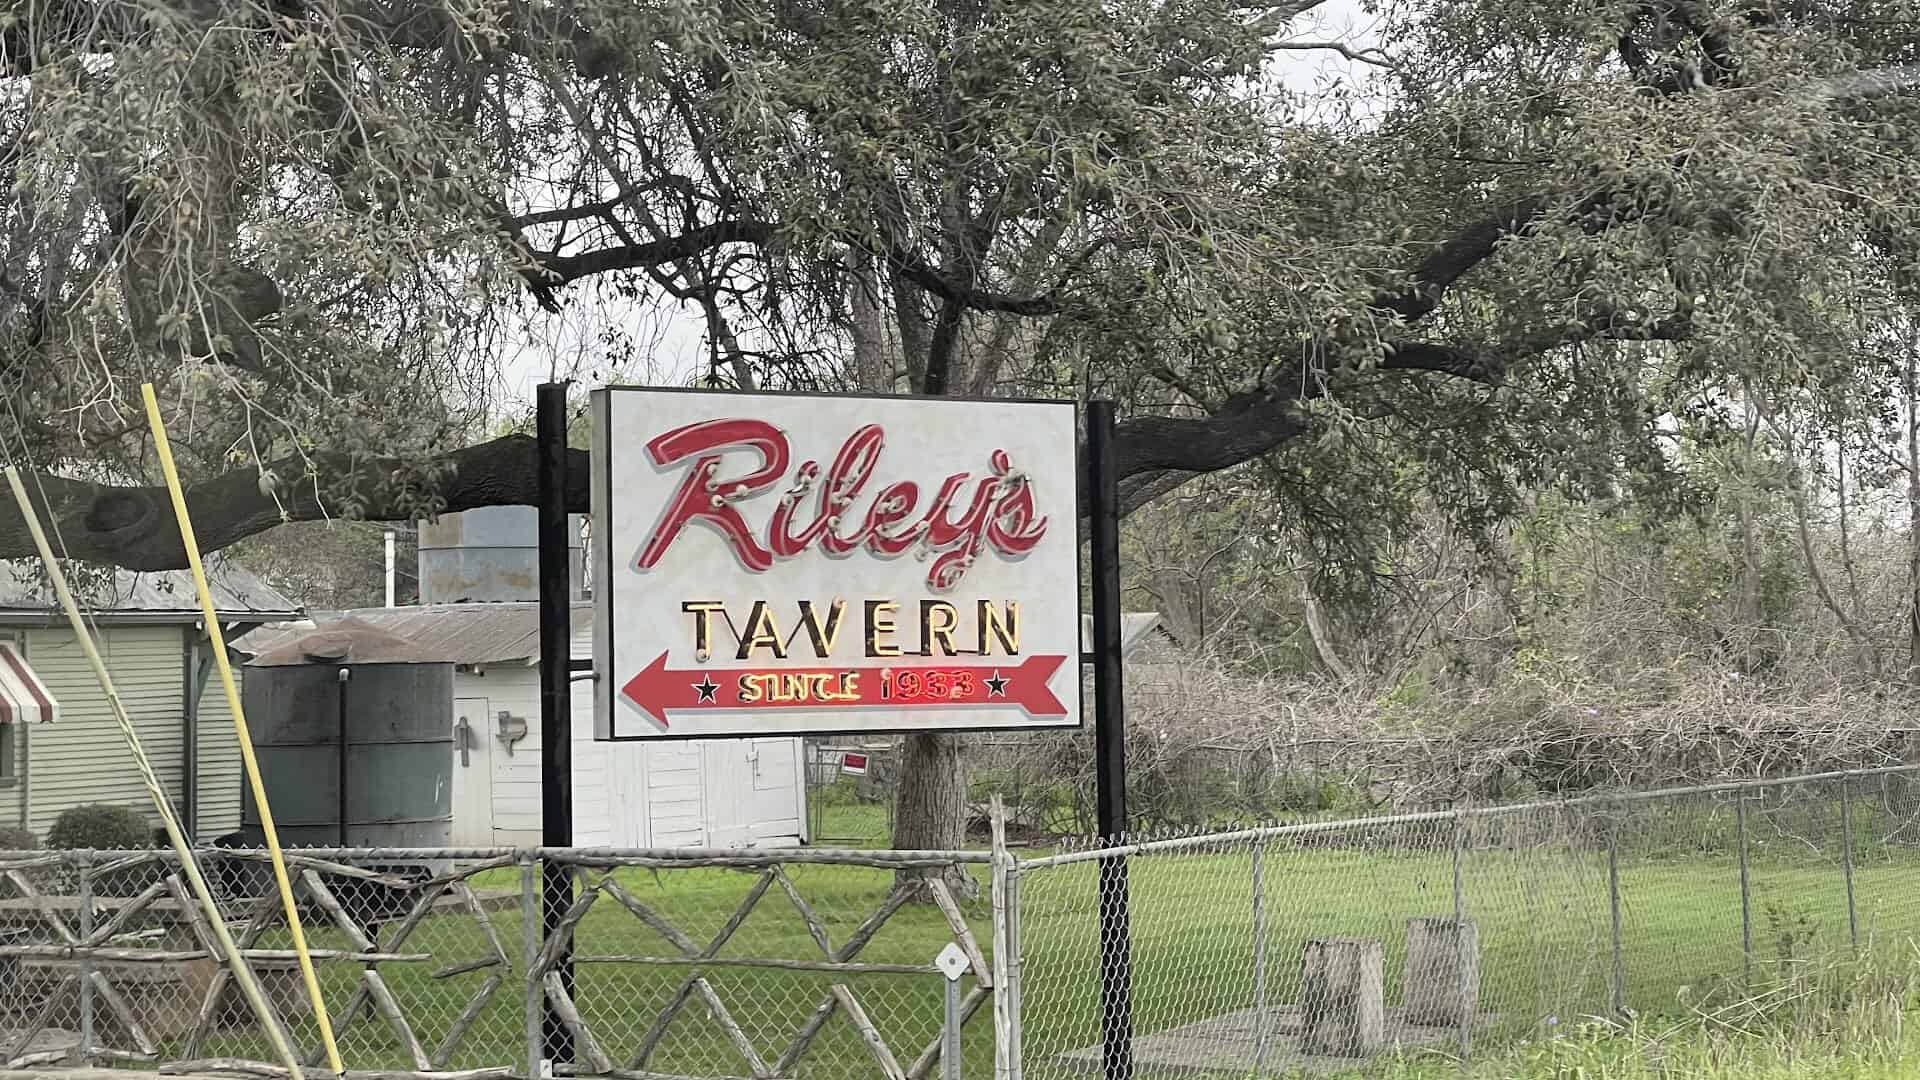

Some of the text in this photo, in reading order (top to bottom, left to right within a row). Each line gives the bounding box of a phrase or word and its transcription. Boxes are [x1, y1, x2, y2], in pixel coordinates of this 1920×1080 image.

[632, 418, 1048, 591] Riley's
[681, 598, 1020, 660] TAVERN
[737, 669, 976, 702] SINCE 1933
